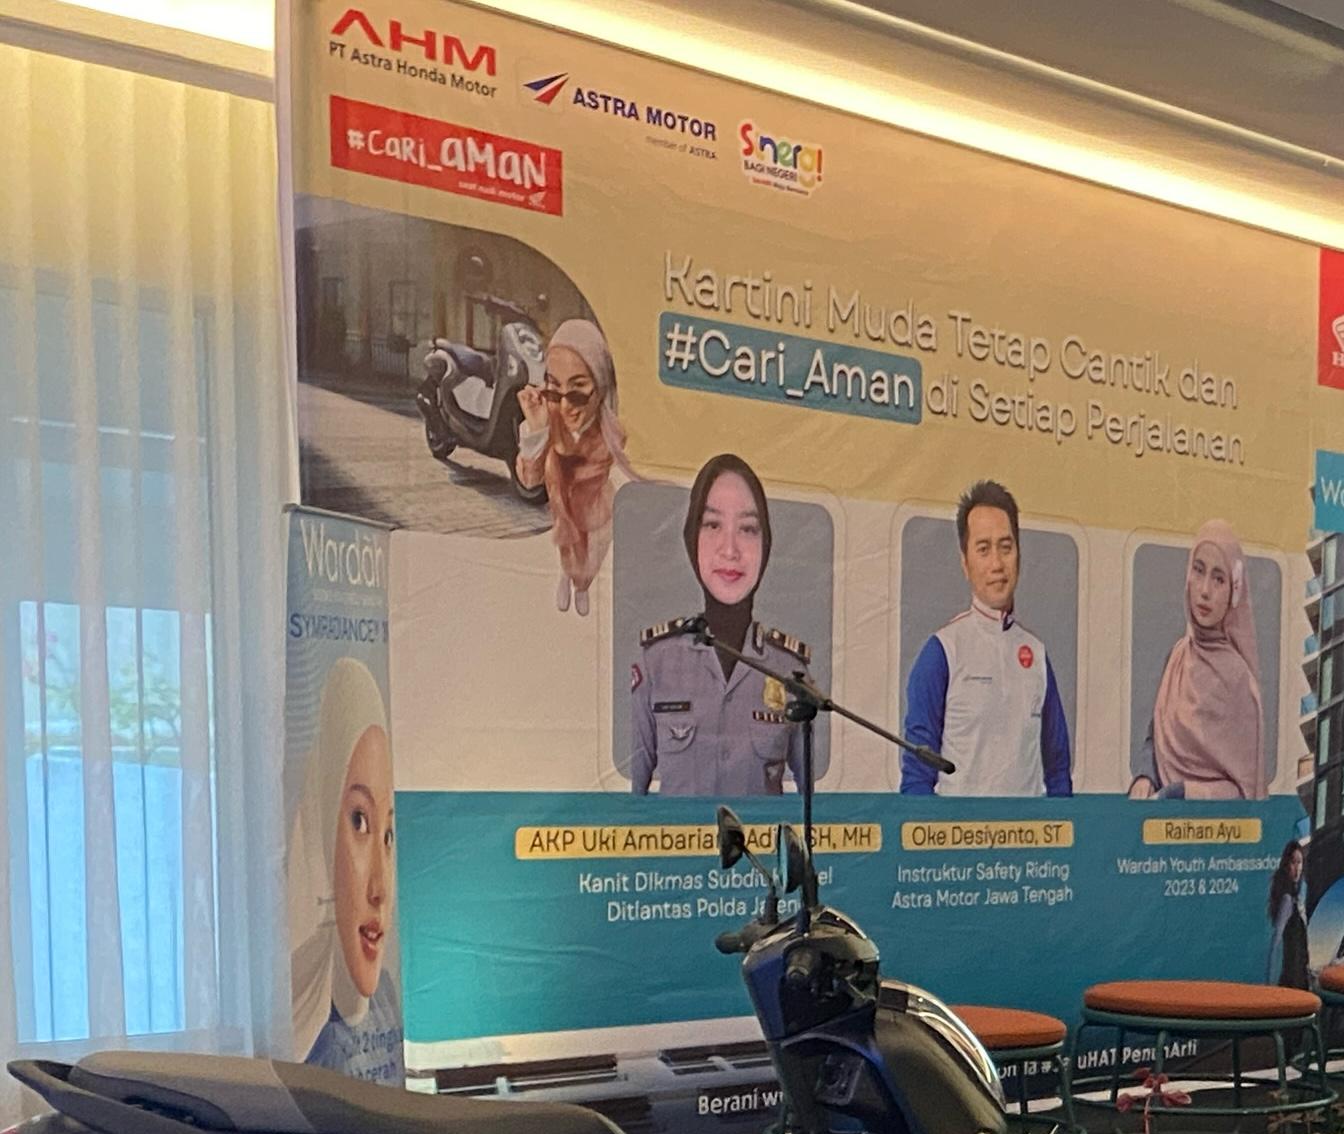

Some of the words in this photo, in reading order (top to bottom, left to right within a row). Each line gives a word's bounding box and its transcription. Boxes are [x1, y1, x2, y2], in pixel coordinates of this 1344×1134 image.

[331, 8, 497, 77] AHM
[329, 41, 346, 58] PT
[351, 49, 393, 71] Astra
[397, 61, 446, 85] Honda
[450, 74, 498, 98] Motor
[572, 88, 639, 121] ASTRA
[646, 106, 717, 141] MOTOR
[664, 249, 813, 329] Kartini
[828, 286, 937, 351] Muda
[947, 310, 1052, 382] Tetap
[1060, 335, 1171, 397] Cantik
[1178, 358, 1239, 410] dan
[664, 322, 915, 409] #Cari_Aman
[926, 373, 960, 418] di
[968, 378, 1078, 446] Setiap
[1086, 399, 1246, 465] Perjalanan
[529, 830, 575, 852] AKP
[582, 829, 616, 851] Uki
[843, 827, 871, 847] MH
[912, 826, 947, 846] Oke
[952, 825, 1039, 848] Desiyanto,
[1044, 824, 1063, 844] ST
[1165, 822, 1214, 840] Raihan
[1216, 822, 1242, 843] Ayu
[898, 863, 972, 883] Instruktur
[976, 861, 1022, 883] Safety
[1026, 859, 1070, 881] Riding
[1117, 856, 1167, 875] Wardah
[1170, 856, 1205, 873] Youth
[579, 872, 629, 894] Kanit
[1164, 878, 1195, 897] 2023
[1209, 877, 1239, 895] 2024
[608, 899, 692, 922] Ditlantas
[697, 897, 747, 918] Polda
[891, 889, 932, 909] Astra
[936, 888, 980, 907] Motor
[984, 887, 1018, 906] Jawa
[1022, 885, 1073, 906] Tengah
[698, 1087, 758, 1115] Berani
